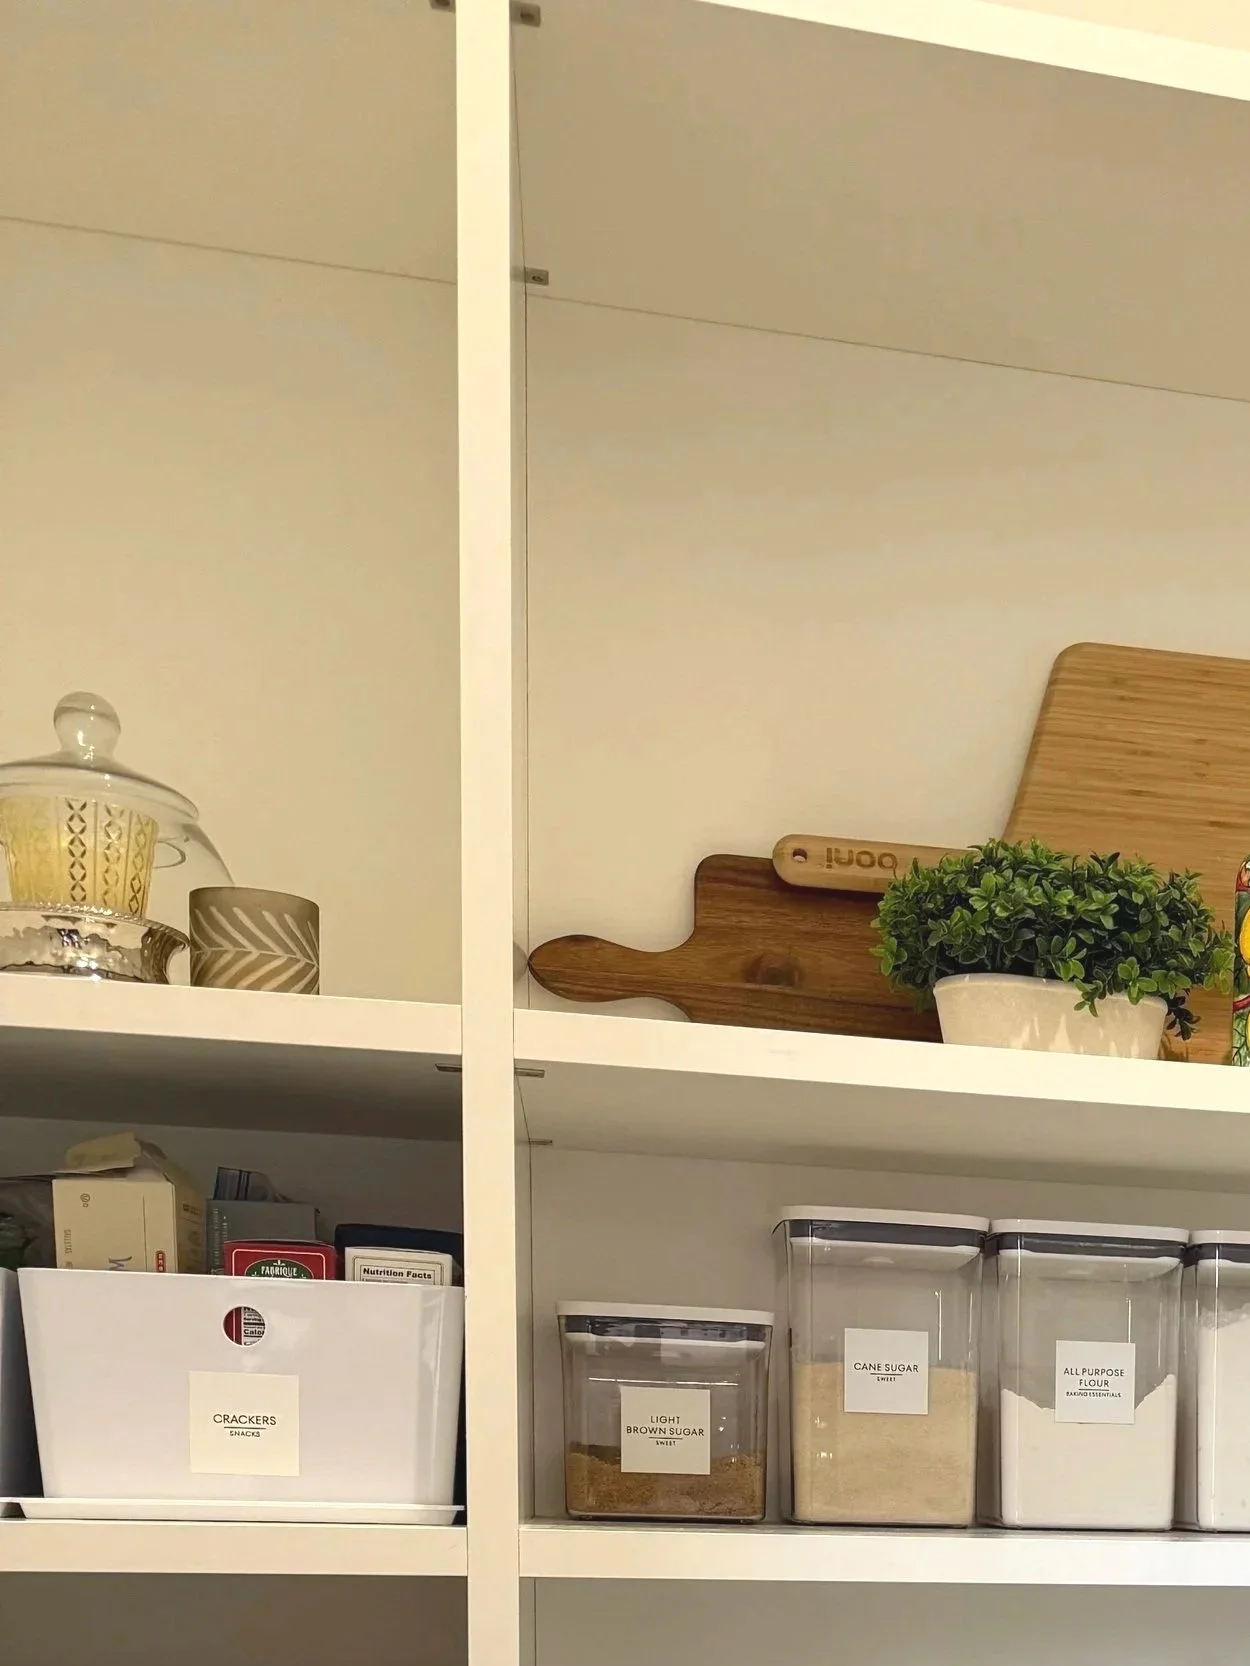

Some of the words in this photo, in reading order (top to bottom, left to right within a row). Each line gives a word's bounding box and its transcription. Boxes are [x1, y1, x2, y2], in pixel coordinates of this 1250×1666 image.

[261, 1266, 298, 1276] FABRIQUE
[362, 1267, 404, 1278] Nutrition
[406, 1270, 433, 1280] Facts
[854, 1362, 882, 1372] CANE
[884, 1362, 919, 1373] SUGAR
[1063, 1367, 1082, 1376] ALL
[1082, 1368, 1125, 1377] PURPOSE
[1079, 1379, 1109, 1388] FLOUR
[213, 1413, 277, 1426] CRACKERS
[650, 1415, 680, 1425] LIGHT
[229, 1430, 261, 1438] SNACKS
[626, 1425, 667, 1436] BROWN
[669, 1427, 705, 1437] SUGAR
